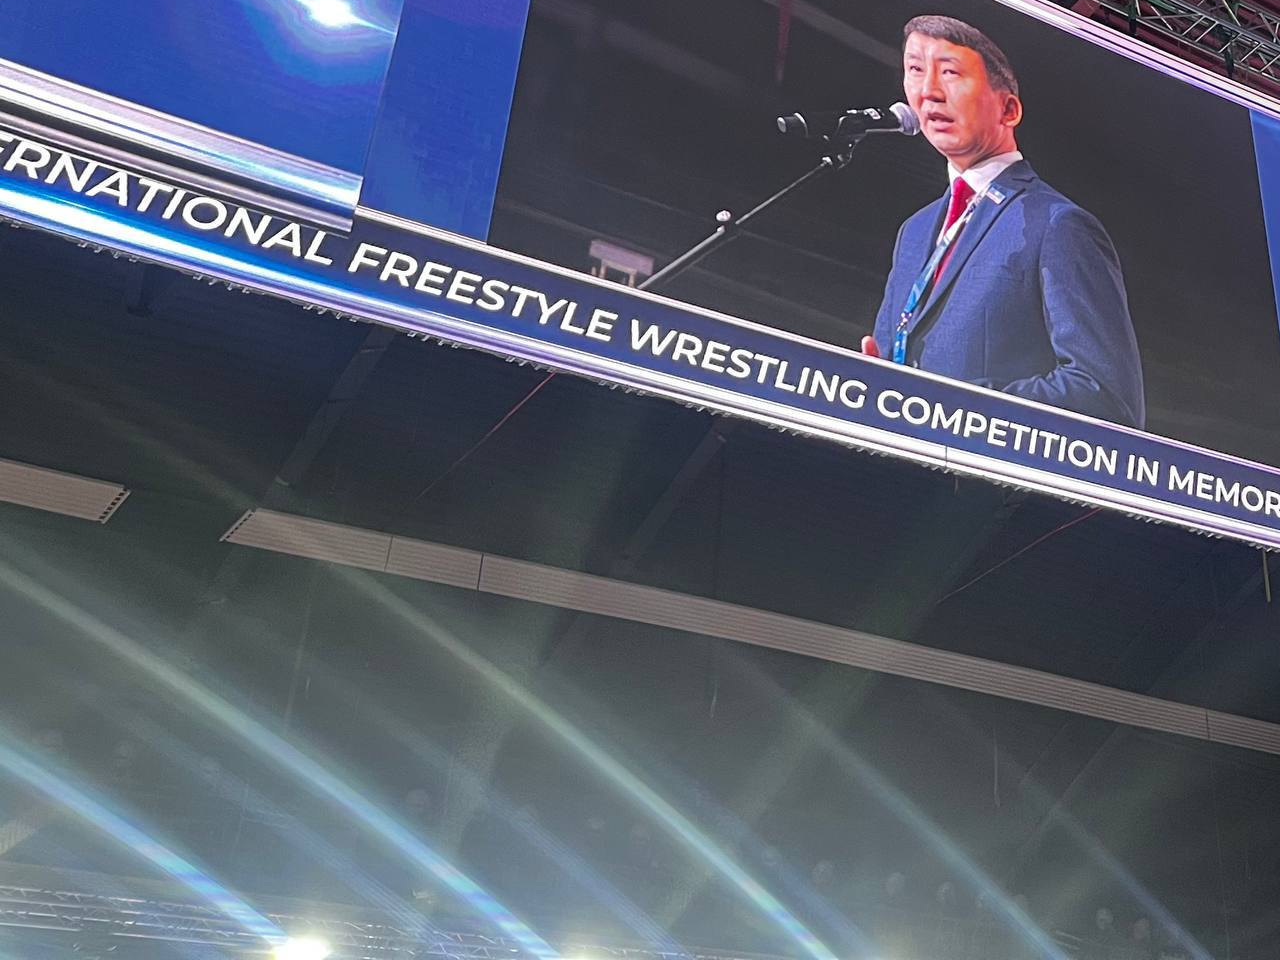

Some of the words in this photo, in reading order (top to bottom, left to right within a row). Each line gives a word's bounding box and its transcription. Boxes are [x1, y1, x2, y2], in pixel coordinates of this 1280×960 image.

[347, 243, 618, 341] FREESTYLE
[629, 319, 868, 409] WRESTLING
[876, 390, 1118, 476] COMPETITION
[1126, 454, 1159, 486] IN
